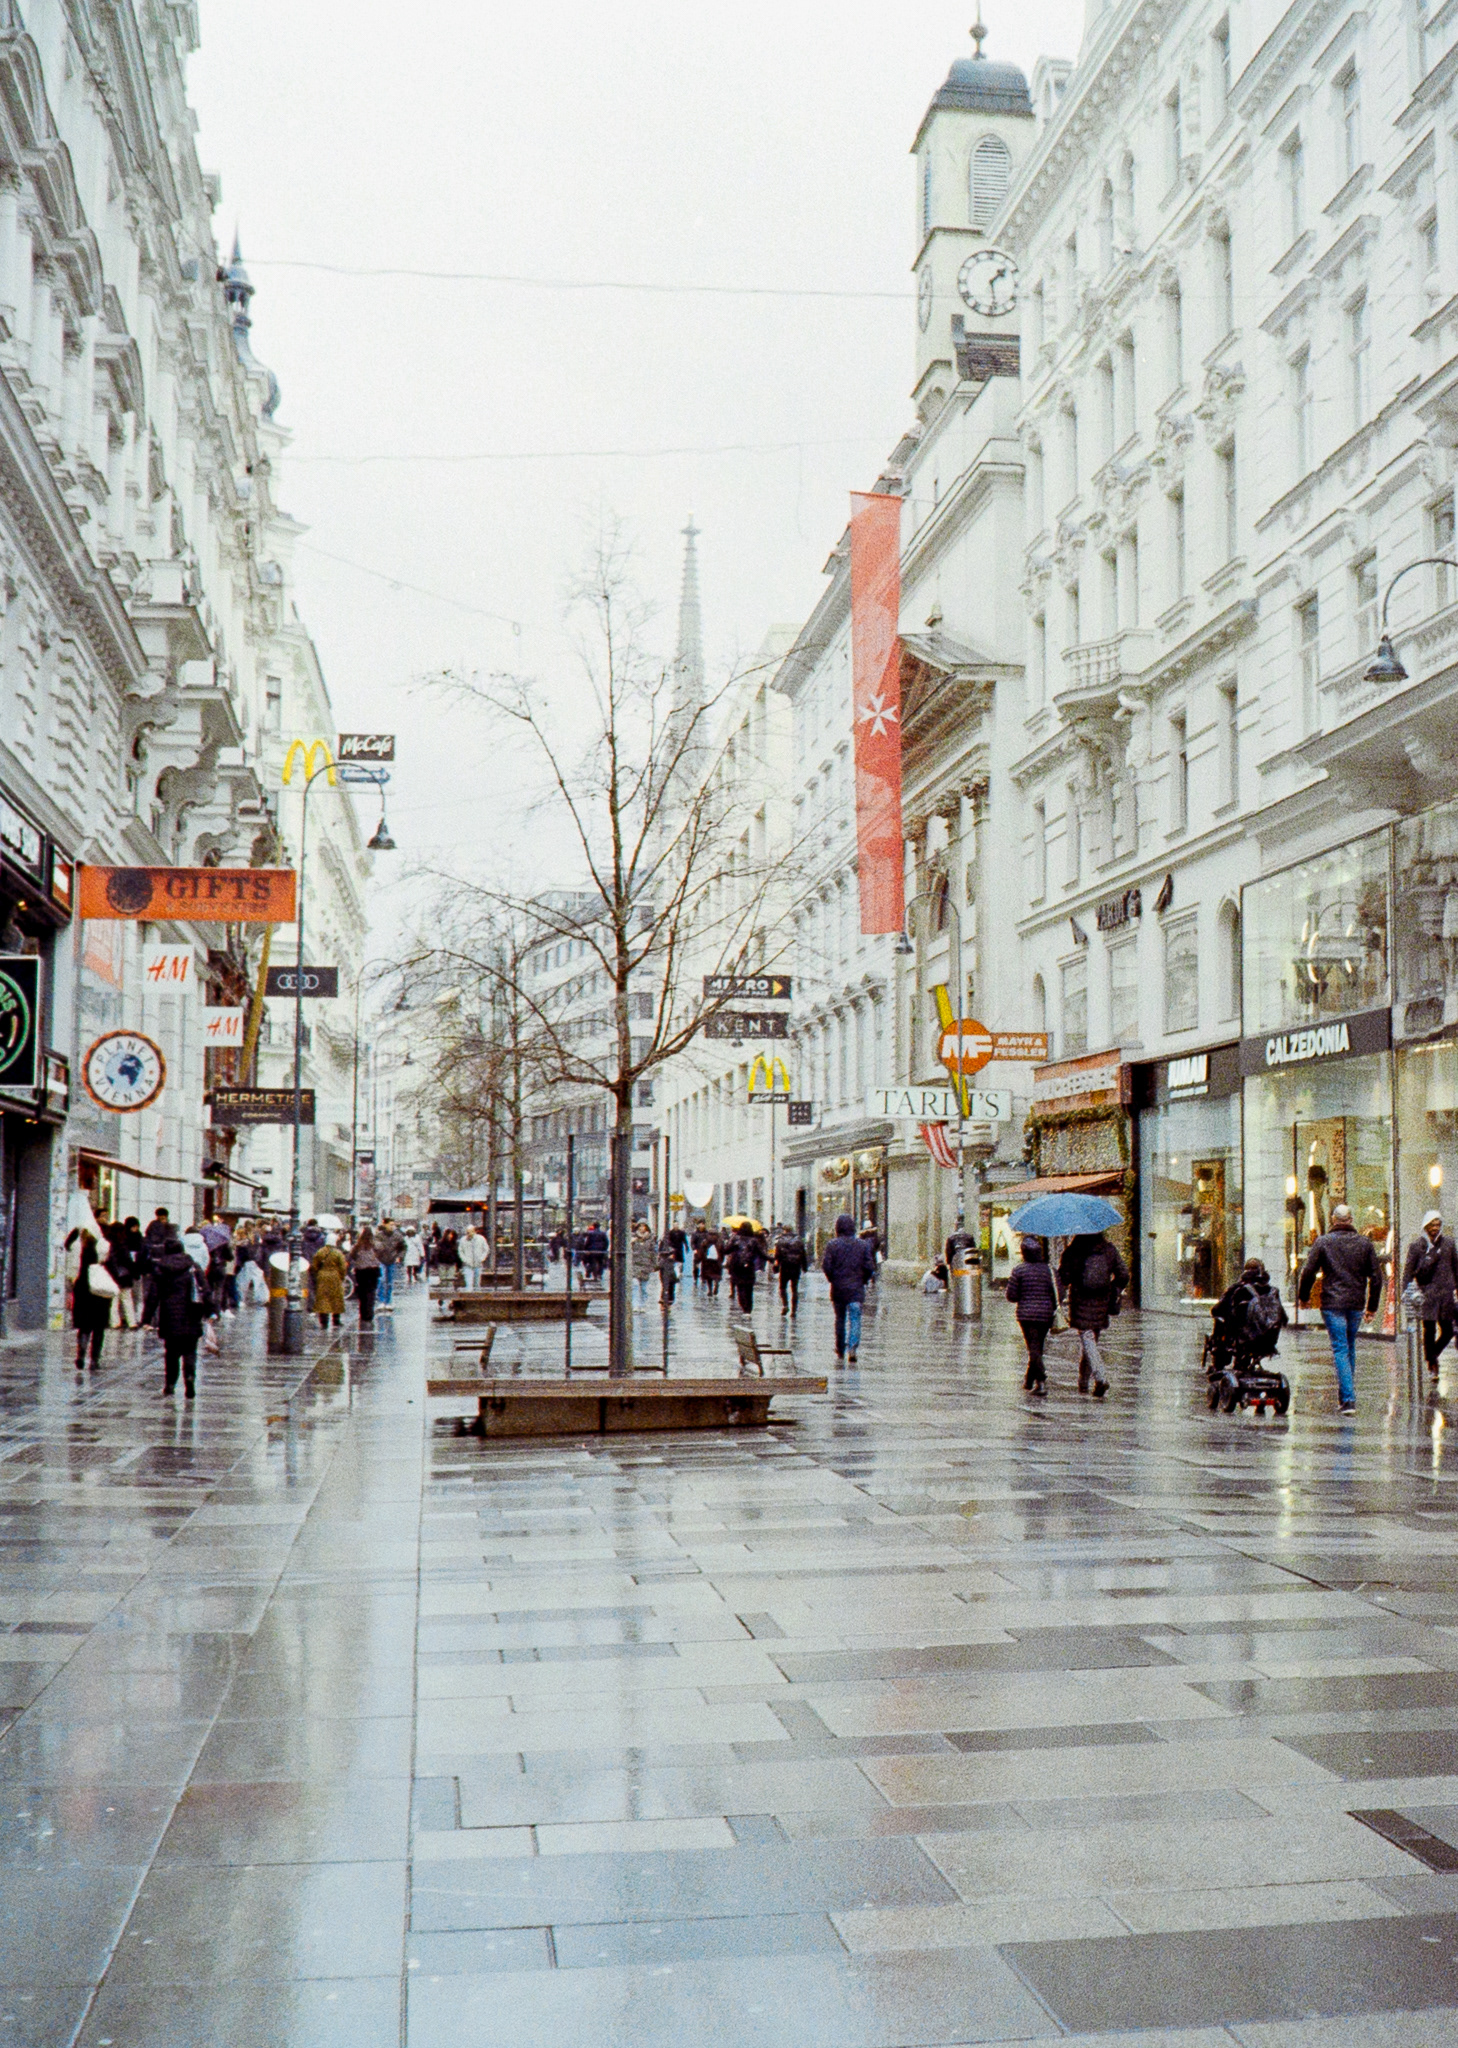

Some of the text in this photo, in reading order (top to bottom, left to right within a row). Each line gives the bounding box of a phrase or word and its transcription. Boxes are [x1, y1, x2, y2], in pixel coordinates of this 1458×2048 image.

[165, 875, 271, 899] GIFTS
[716, 1018, 776, 1033] KENT
[96, 1040, 154, 1063] PLANET
[941, 1035, 994, 1059] MF
[1265, 1023, 1350, 1066] CALZEDONIA
[95, 1078, 154, 1103] VIENNA
